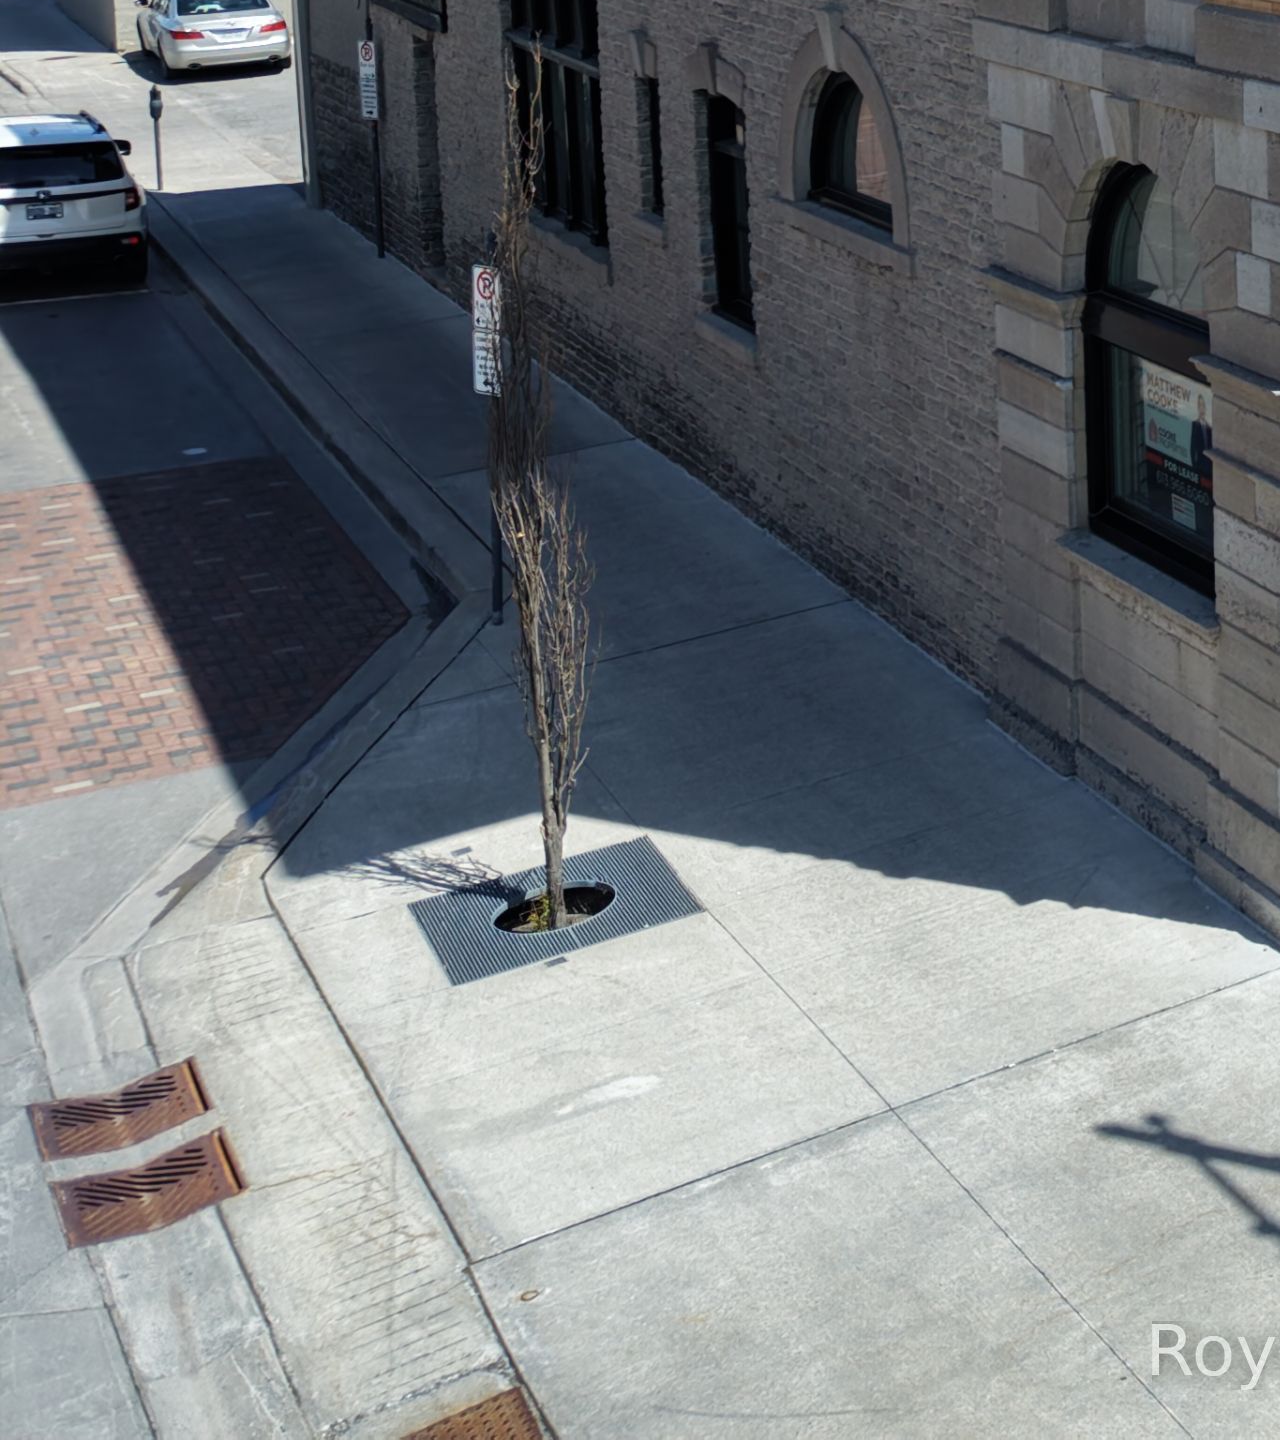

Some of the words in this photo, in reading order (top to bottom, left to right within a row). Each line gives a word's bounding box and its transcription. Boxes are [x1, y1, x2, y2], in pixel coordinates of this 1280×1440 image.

[1146, 372, 1192, 402] MATTHEW
[1146, 388, 1179, 409] COOKE
[1164, 460, 1178, 474] FOR
[1178, 463, 1199, 484] LEASE
